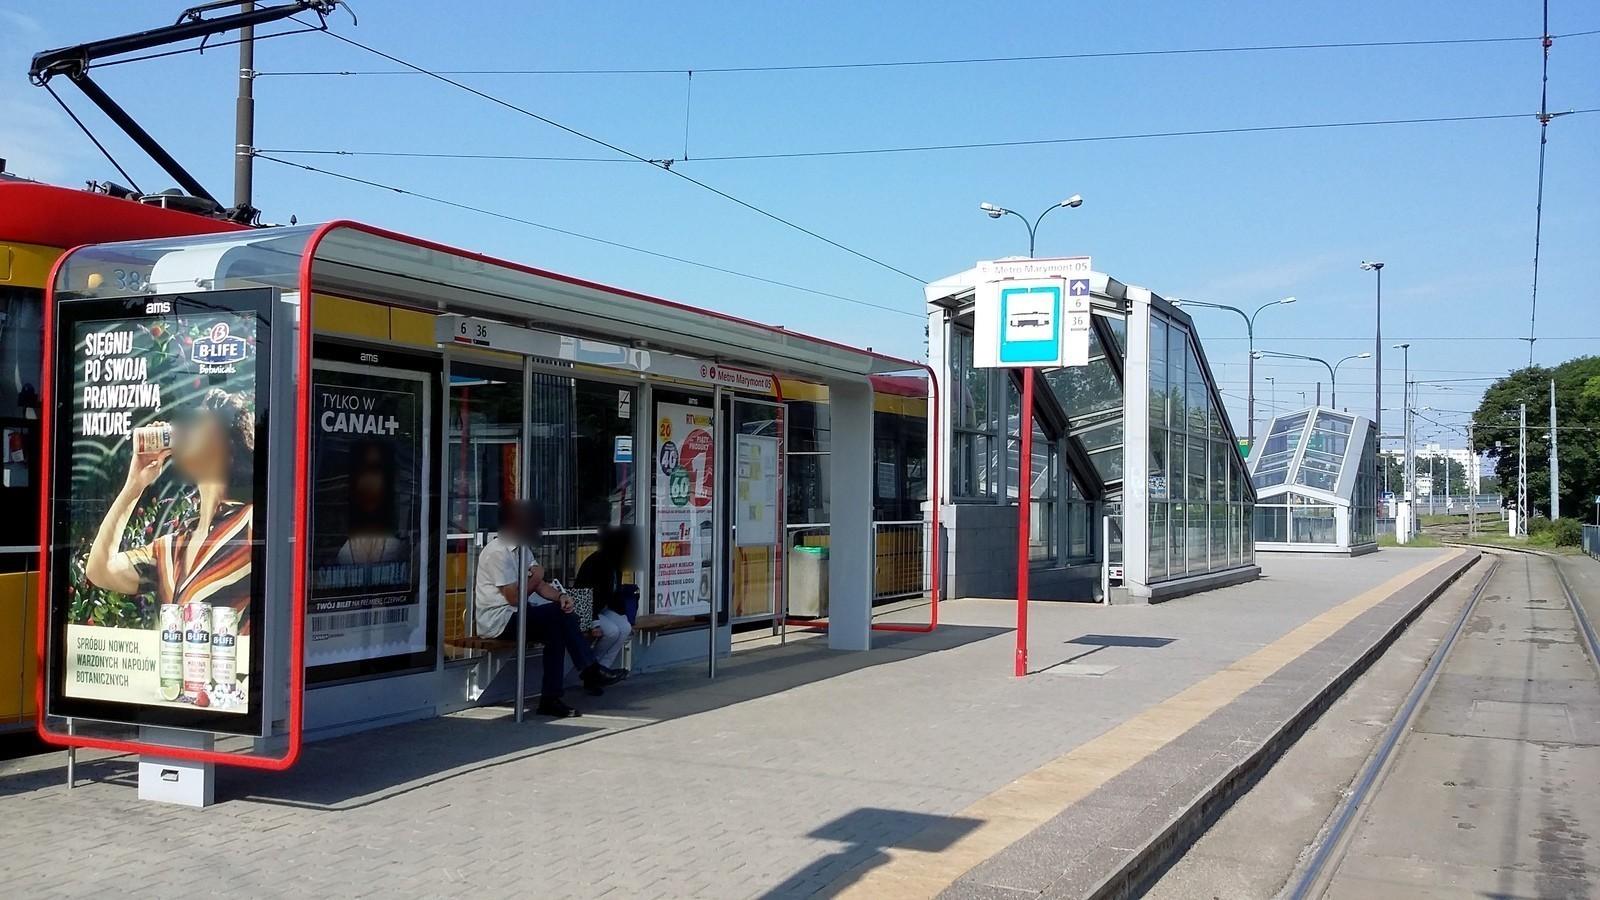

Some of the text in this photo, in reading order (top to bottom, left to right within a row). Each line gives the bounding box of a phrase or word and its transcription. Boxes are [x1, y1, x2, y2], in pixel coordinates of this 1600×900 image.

[994, 262, 1087, 275] Metro Marymont 05
[145, 301, 171, 314] ams
[1075, 299, 1082, 308] 6
[460, 322, 487, 337] 6 36
[84, 330, 134, 361] SIĘGNIJ
[359, 352, 379, 363] ams
[84, 357, 147, 384] PO SWOJĄ
[717, 370, 772, 389] Metro Marymont 05
[83, 385, 161, 412] PRAWDZIWĄ
[322, 393, 376, 411] TYLKO W
[82, 412, 133, 440] NATURĘ
[320, 410, 400, 436] CANAL+
[660, 423, 671, 438] 20
[661, 450, 677, 469] 40
[691, 452, 707, 499] 1
[671, 477, 689, 498] 60
[679, 522, 685, 540] 1
[316, 601, 336, 610] TWÓJ
[336, 600, 352, 609] BILET
[657, 589, 695, 608] RAVEN
[76, 636, 141, 655] SPRÓBUJ NOWYCH,
[76, 653, 119, 670] WARZONYCH
[121, 656, 156, 673] NAPOJÓW
[75, 670, 129, 687] BOTANICZNYCH
